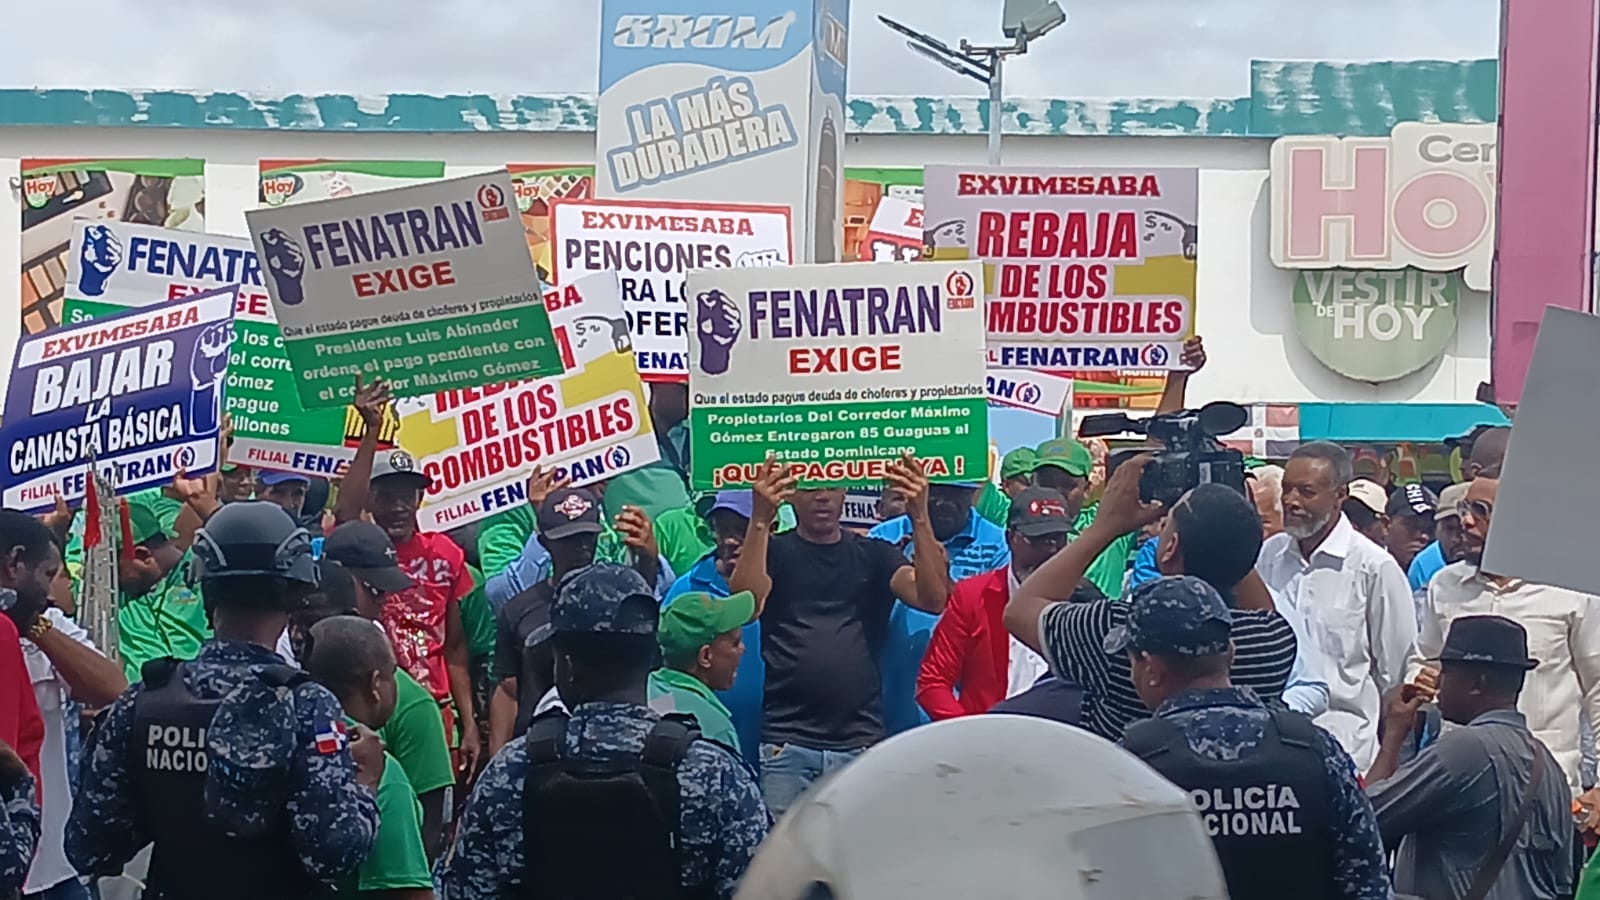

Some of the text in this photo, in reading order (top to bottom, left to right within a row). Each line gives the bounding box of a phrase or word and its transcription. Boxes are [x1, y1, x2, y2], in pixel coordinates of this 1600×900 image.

[631, 82, 754, 145] LA MÁS
[611, 109, 793, 188] DURADERA
[958, 174, 1161, 197] EXVIMESABA
[1288, 147, 1494, 257] HO
[303, 200, 483, 270] FENATRAN
[582, 211, 754, 236] EXVIMESABA
[977, 211, 1138, 259] REBAJA
[565, 239, 731, 273] PENCIONES
[352, 261, 456, 298] EXIGE
[1000, 264, 1107, 299] DE LOS
[1302, 271, 1448, 306] VESTIR
[283, 326, 303, 337] Que
[305, 323, 314, 335] el
[315, 320, 348, 332] estado
[380, 311, 410, 324] deuda
[412, 309, 425, 320] de
[427, 303, 469, 317] choferes
[469, 303, 477, 314] y
[479, 292, 539, 311] propietarios
[748, 285, 942, 339] FENATRAN
[985, 301, 1183, 334] MBUSTIBLES
[1316, 303, 1435, 341] DE HOY
[41, 306, 199, 359] EXVIMESABA
[243, 329, 269, 346] los
[314, 318, 520, 357] Presidente Luis Abinader
[303, 336, 545, 380] ordene el pago pendiente con
[789, 345, 902, 374] EXIGE
[1001, 347, 1139, 366] FENATRAN
[31, 339, 175, 415] BAJAR
[318, 386, 335, 400] el
[413, 368, 479, 386] Máximo
[482, 359, 541, 377] Gómez
[85, 397, 111, 423] LA
[226, 396, 279, 414] pague
[694, 393, 717, 405] Que
[719, 392, 729, 404] el
[732, 392, 769, 404] estado
[772, 392, 806, 405] pague
[808, 389, 842, 401] deuda
[844, 387, 858, 400] de
[861, 386, 907, 399] choferes
[910, 388, 918, 400] y
[920, 384, 984, 400] propietarios
[462, 401, 499, 446] DE
[504, 383, 557, 432] LOS
[707, 405, 971, 427] Propietarios Del Corredor Máximo
[10, 404, 184, 474] CANASTA BÁSICA
[423, 398, 633, 495] COMBUSTIBLES
[709, 424, 969, 443] Gómez Entregaron 85 Guaguas al
[248, 448, 290, 464] FILIAL
[765, 445, 916, 460] Estado Dominicano
[20, 482, 60, 502] FILIAL
[435, 500, 481, 524] FILIAL
[845, 501, 876, 519] FENA
[148, 725, 205, 748] POLI
[146, 748, 208, 772] NACIO
